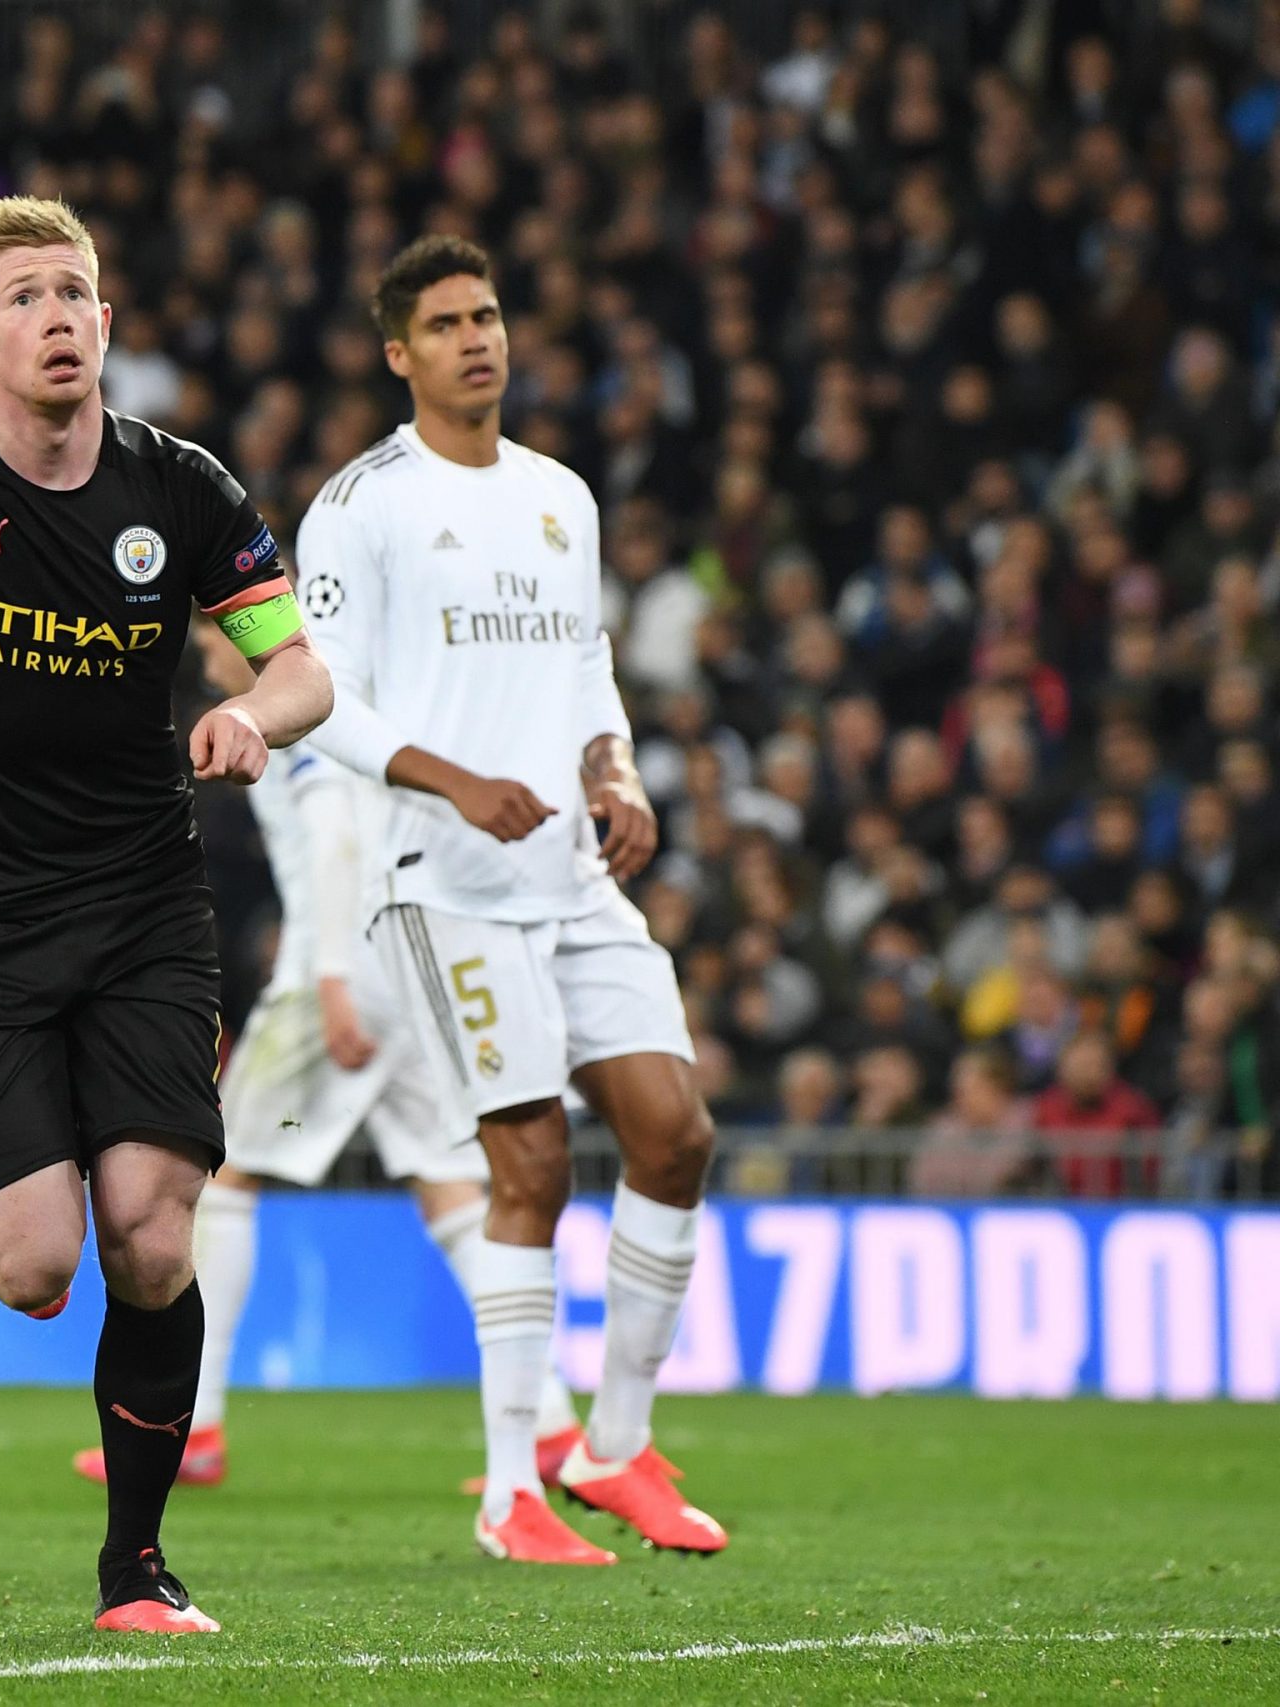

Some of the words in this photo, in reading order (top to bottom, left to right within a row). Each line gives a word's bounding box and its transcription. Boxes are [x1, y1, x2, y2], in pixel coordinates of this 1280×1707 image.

[118, 529, 160, 549] MANCHESTER
[125, 594, 137, 603] 125
[138, 593, 161, 602] YEARS
[495, 571, 537, 602] Fly
[450, 956, 498, 1032] 5
